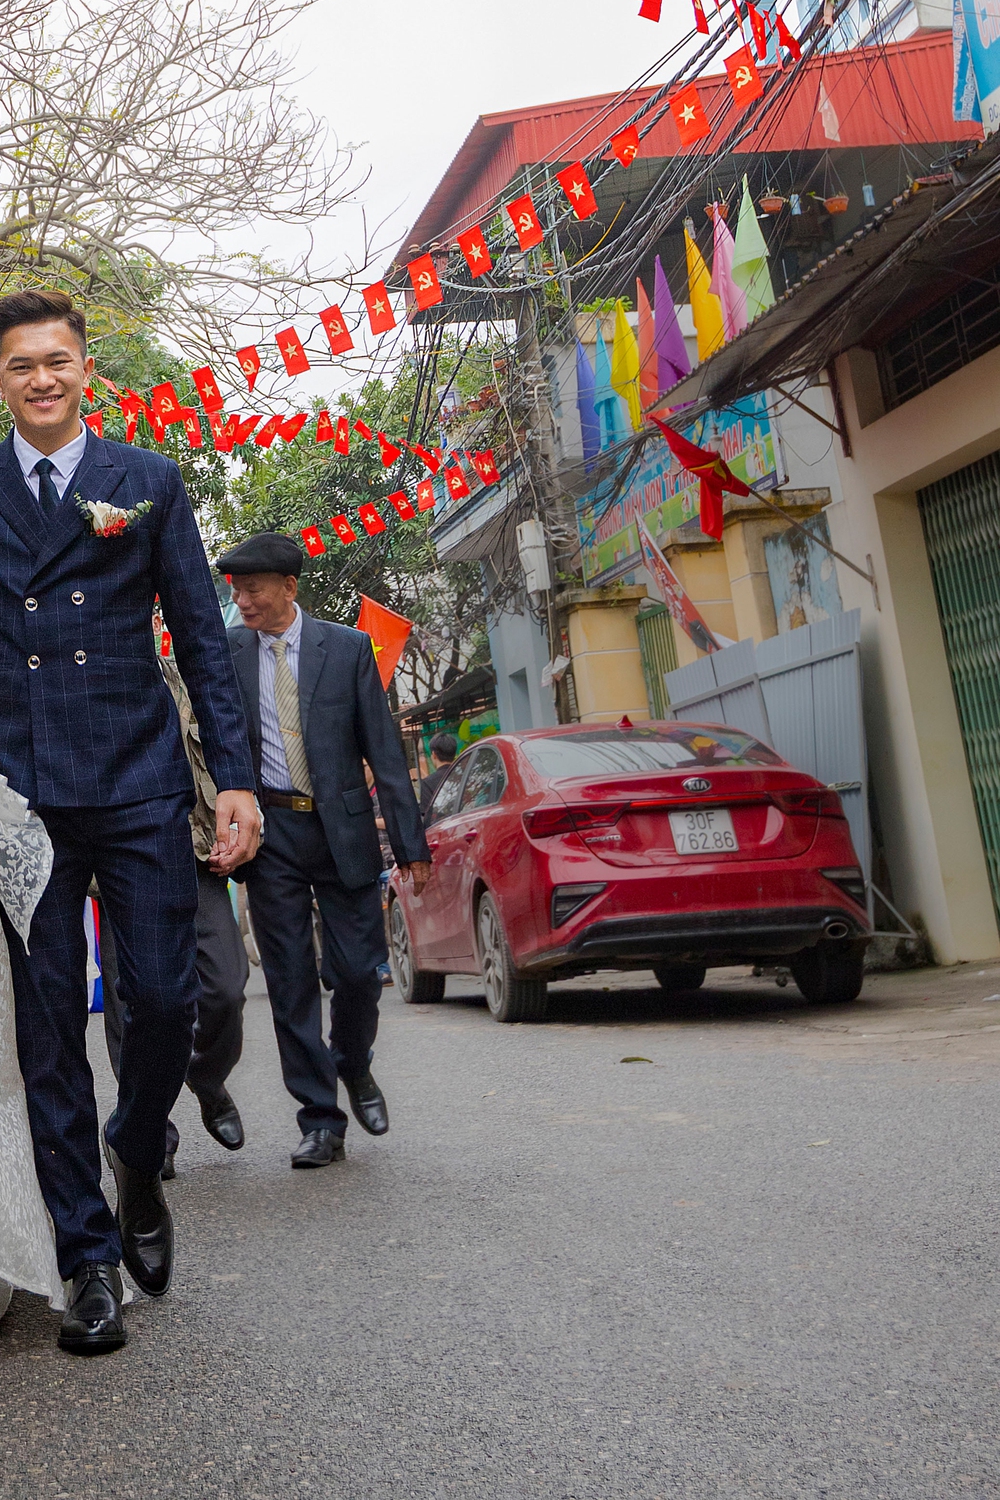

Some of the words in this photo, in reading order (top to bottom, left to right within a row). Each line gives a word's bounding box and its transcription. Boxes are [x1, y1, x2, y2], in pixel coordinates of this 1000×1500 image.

[644, 474, 662, 512] NON
[722, 419, 742, 462] MAI
[685, 812, 714, 830] 30F
[677, 831, 734, 851] 762.86
